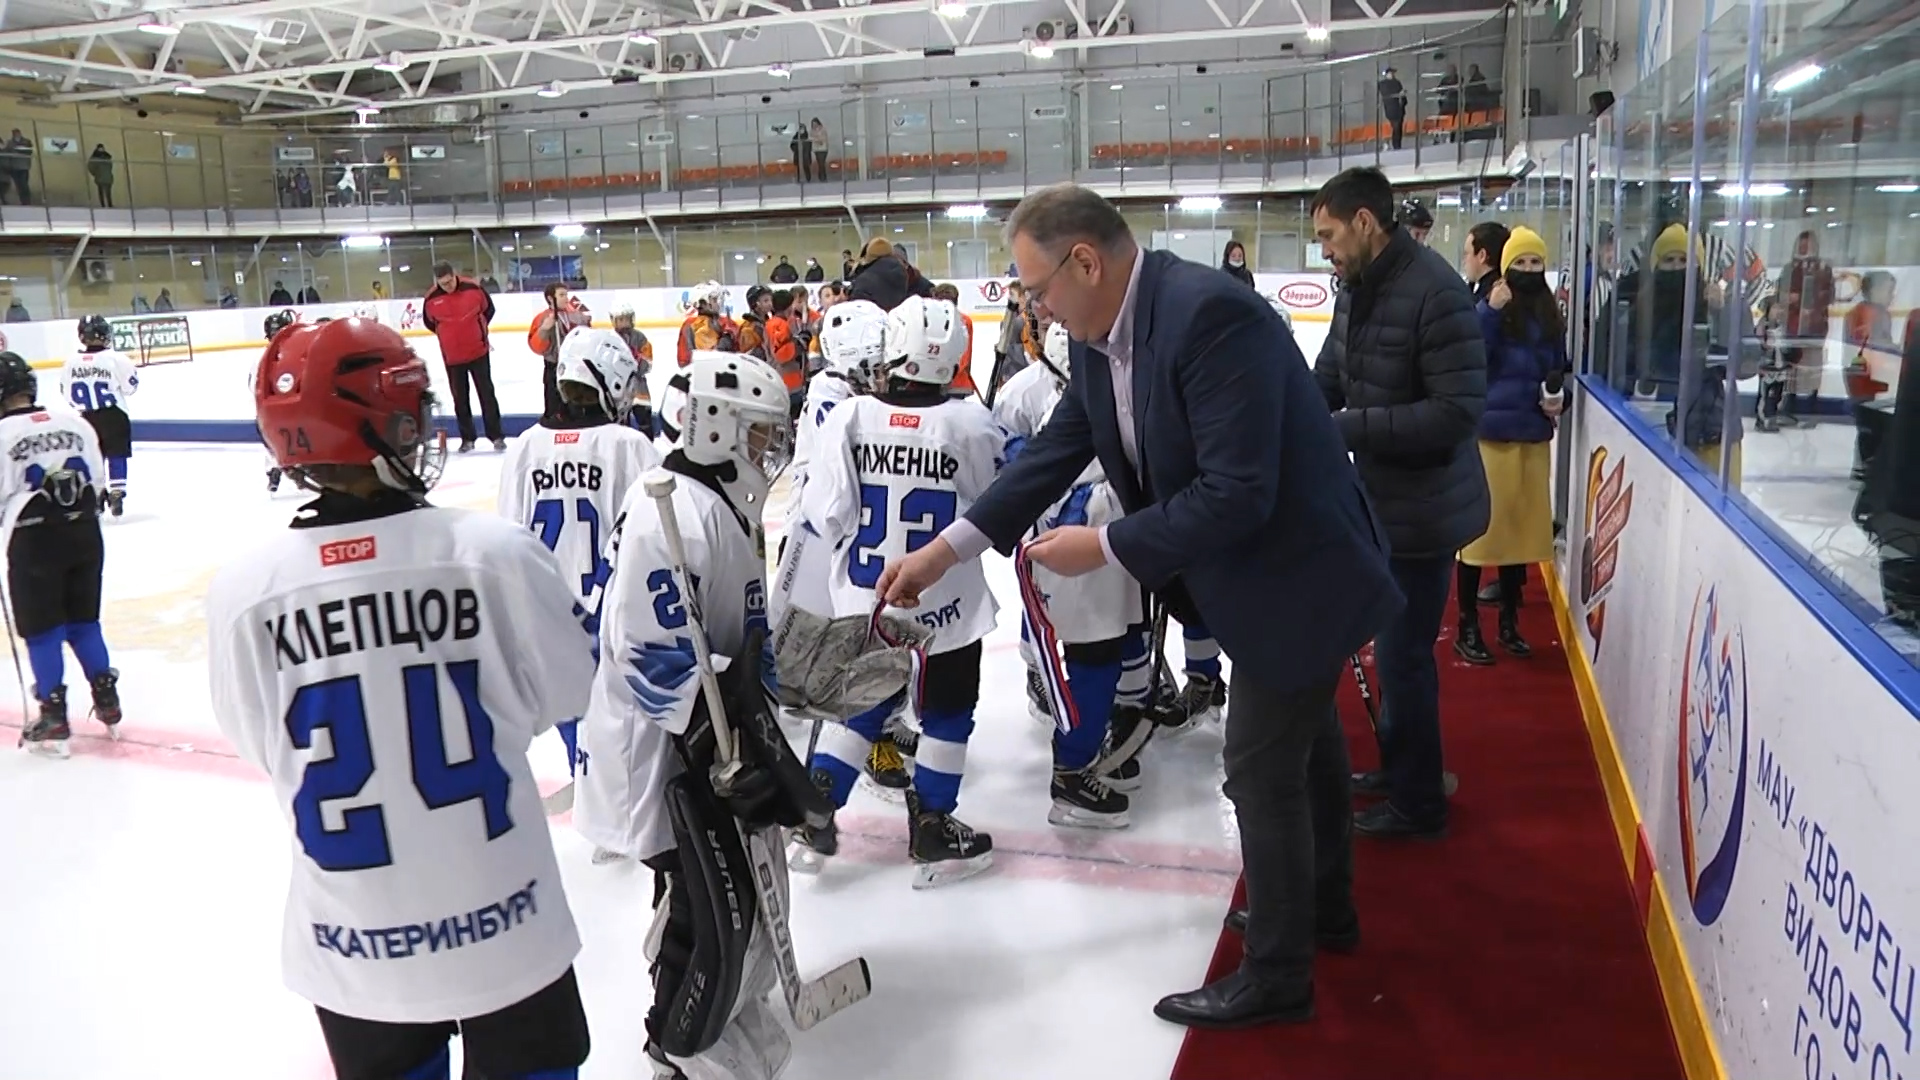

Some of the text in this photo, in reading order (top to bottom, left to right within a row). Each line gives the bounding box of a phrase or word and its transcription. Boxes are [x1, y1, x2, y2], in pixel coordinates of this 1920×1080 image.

[71, 381, 117, 411] 96
[890, 416, 918, 428] STOP
[279, 427, 311, 456] 24
[554, 433, 579, 444] STOP
[323, 540, 374, 563] STOP
[265, 588, 481, 671] КЛЕПЦОВ
[284, 659, 515, 872] 24
[312, 879, 538, 960] ЕКАТЕРИНБУРГ
[1757, 738, 1915, 1055] МАУ «ДВОРЕЦ
[1785, 882, 1862, 1063] ВИДОВ
